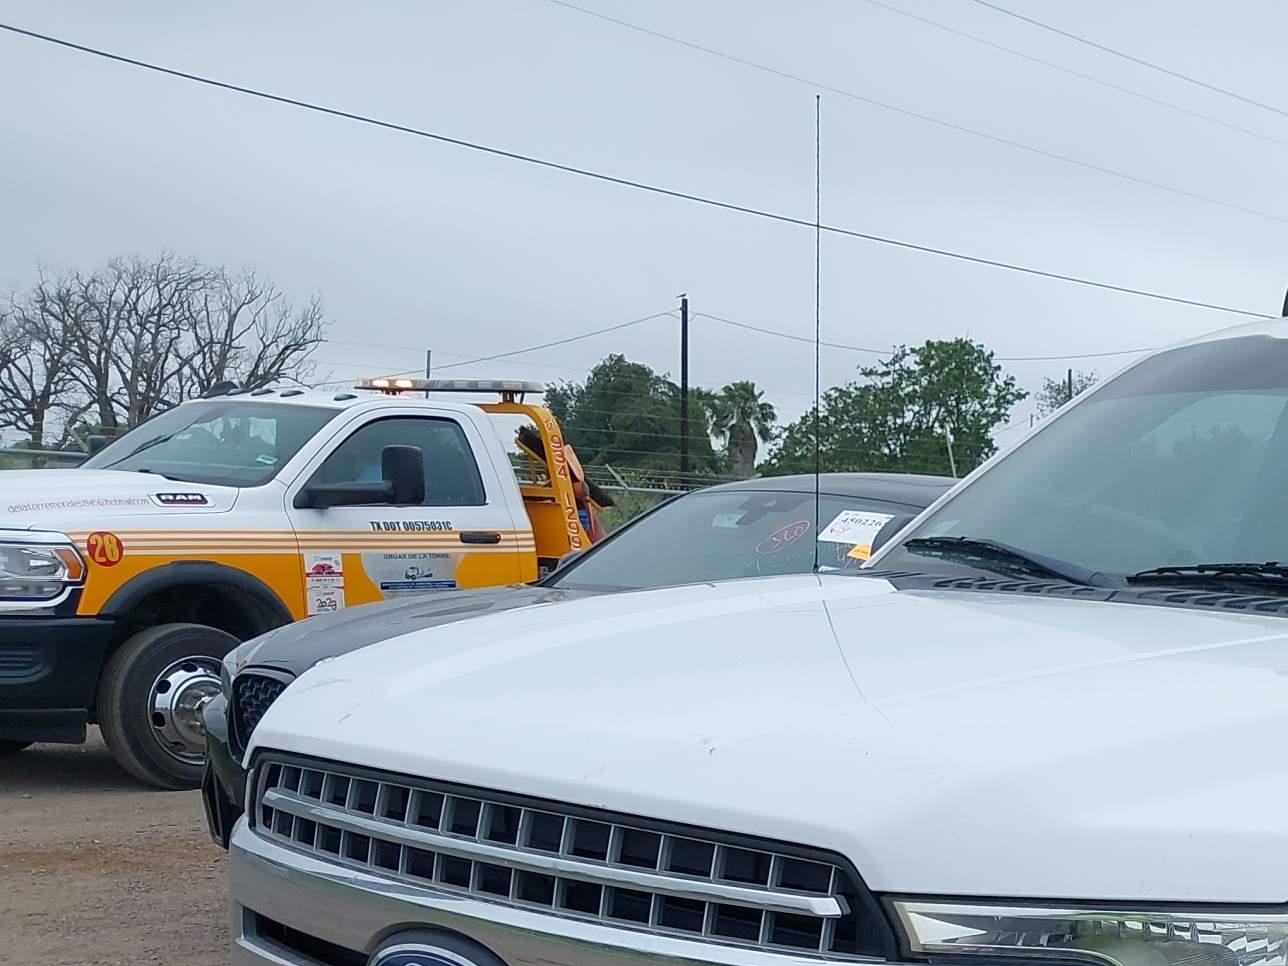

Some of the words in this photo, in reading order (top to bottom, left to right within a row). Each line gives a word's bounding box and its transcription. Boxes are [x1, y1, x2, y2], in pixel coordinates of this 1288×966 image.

[160, 494, 202, 502] RAM
[369, 521, 382, 531] TX
[382, 521, 401, 531] DOT
[90, 534, 120, 563] 28
